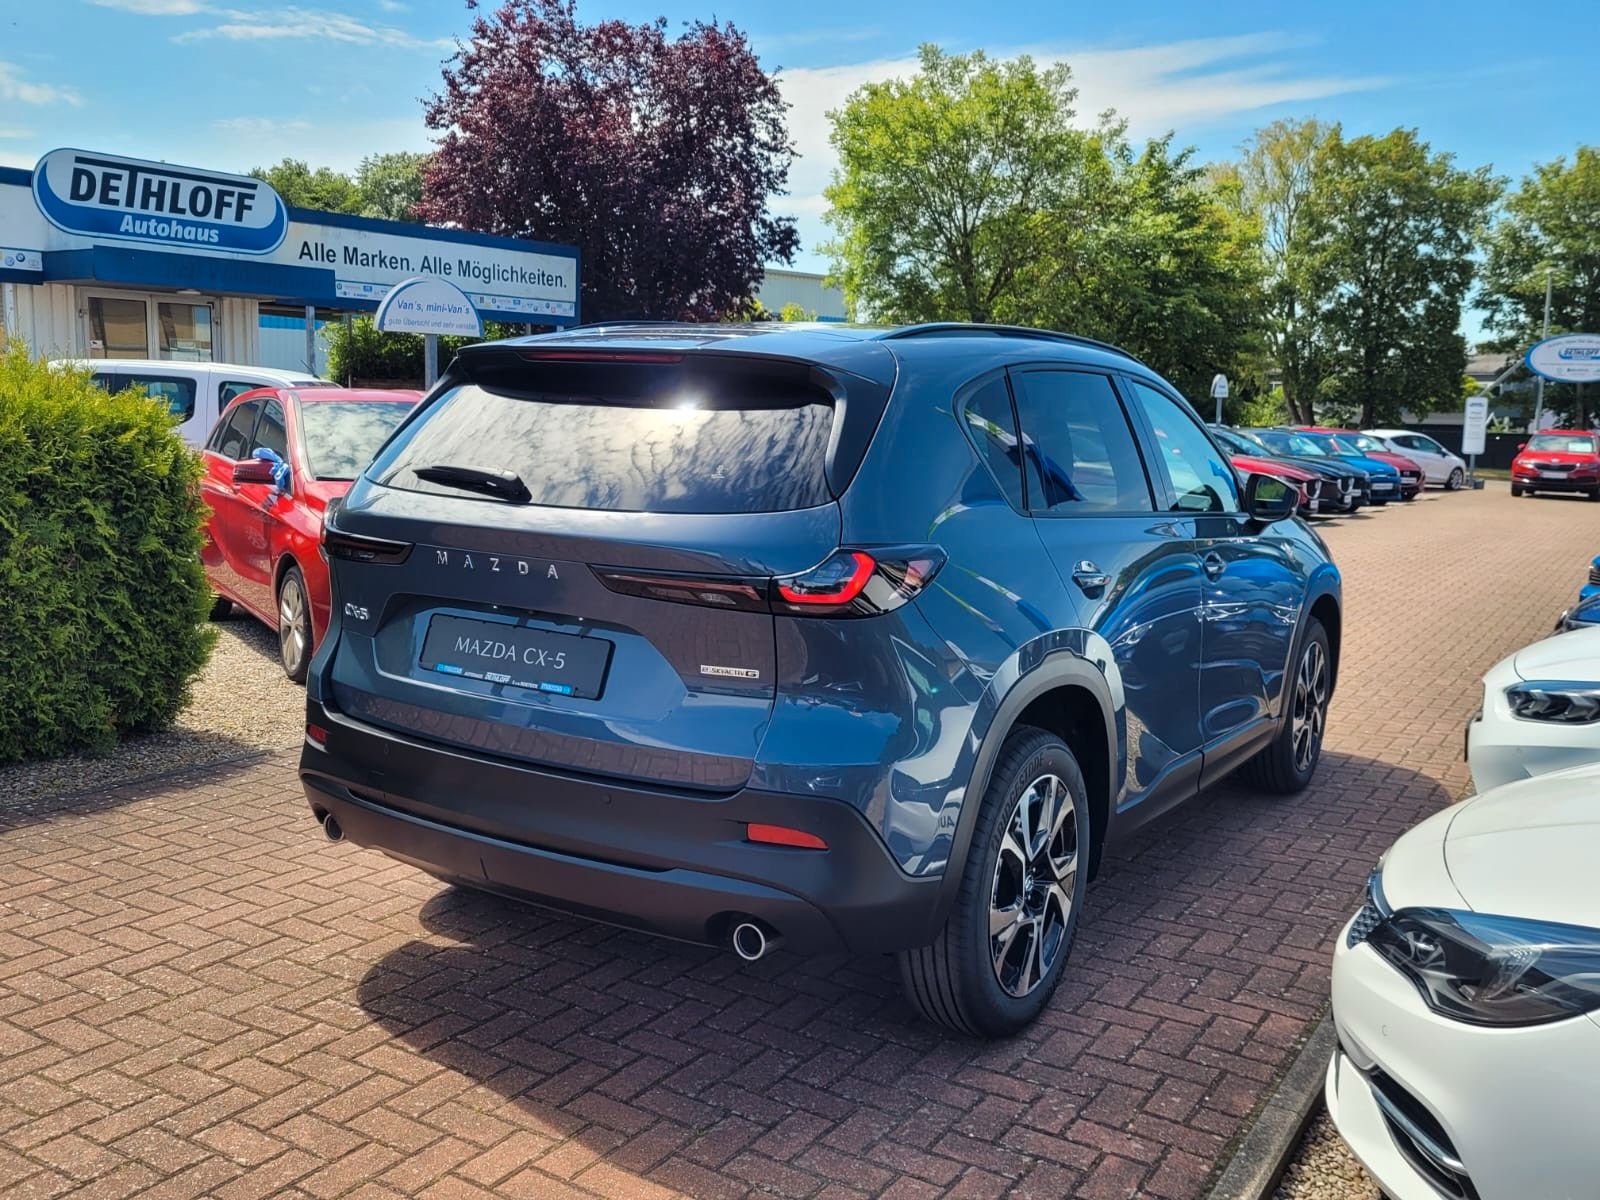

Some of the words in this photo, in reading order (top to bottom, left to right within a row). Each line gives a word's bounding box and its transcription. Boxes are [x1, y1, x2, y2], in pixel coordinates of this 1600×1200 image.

[70, 156, 258, 222] DETHLOFF
[119, 214, 219, 243] Autohaus
[299, 241, 336, 263] Alle
[343, 245, 415, 272] Marken.
[420, 255, 452, 276] Alle
[458, 259, 567, 288] Möglichkeiten.
[436, 550, 559, 580] MAZDA
[454, 636, 516, 662] MAZDA
[523, 647, 566, 670] CX-5
